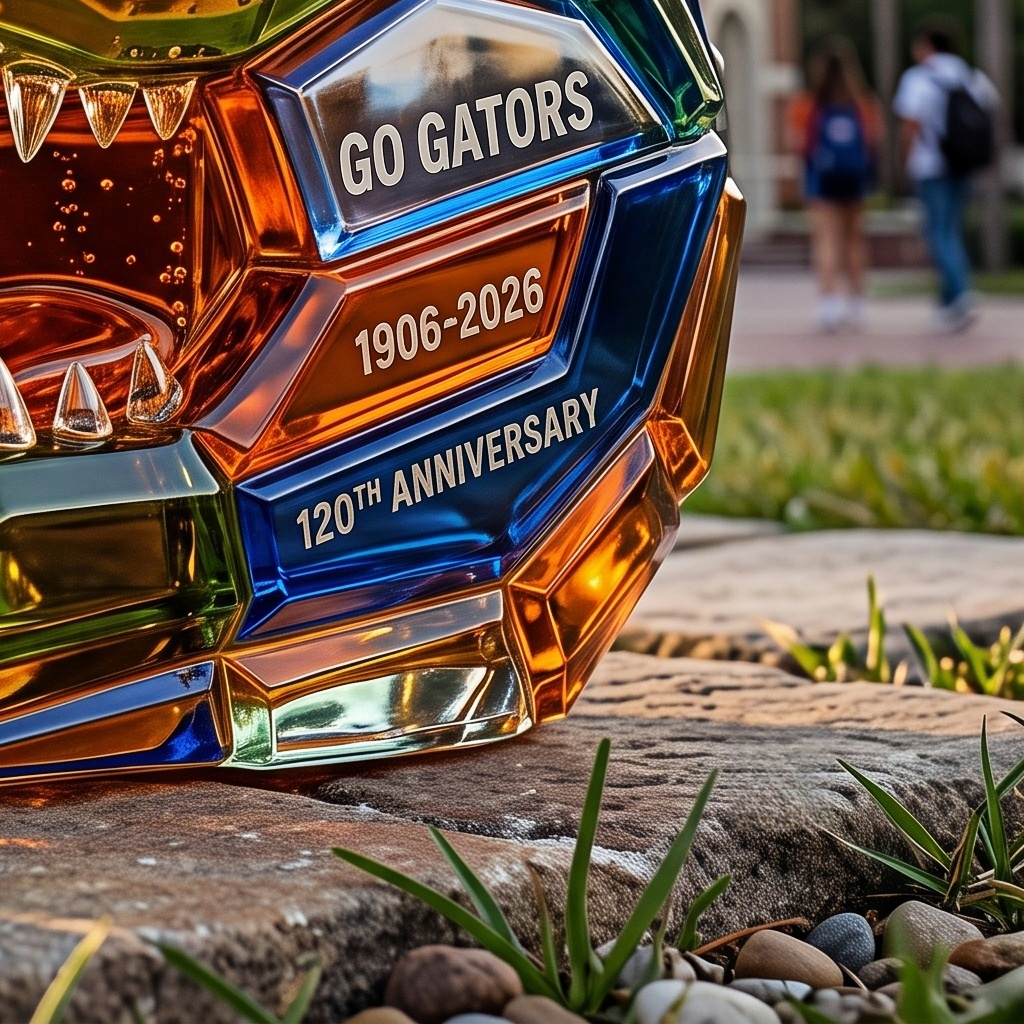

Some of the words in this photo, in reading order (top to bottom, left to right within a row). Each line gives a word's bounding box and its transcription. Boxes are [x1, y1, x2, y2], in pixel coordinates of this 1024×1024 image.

[339, 124, 405, 195] GO
[417, 70, 594, 174] GATORS
[354, 267, 544, 376] 1906-2026
[391, 388, 600, 513] ANNIVERSARY
